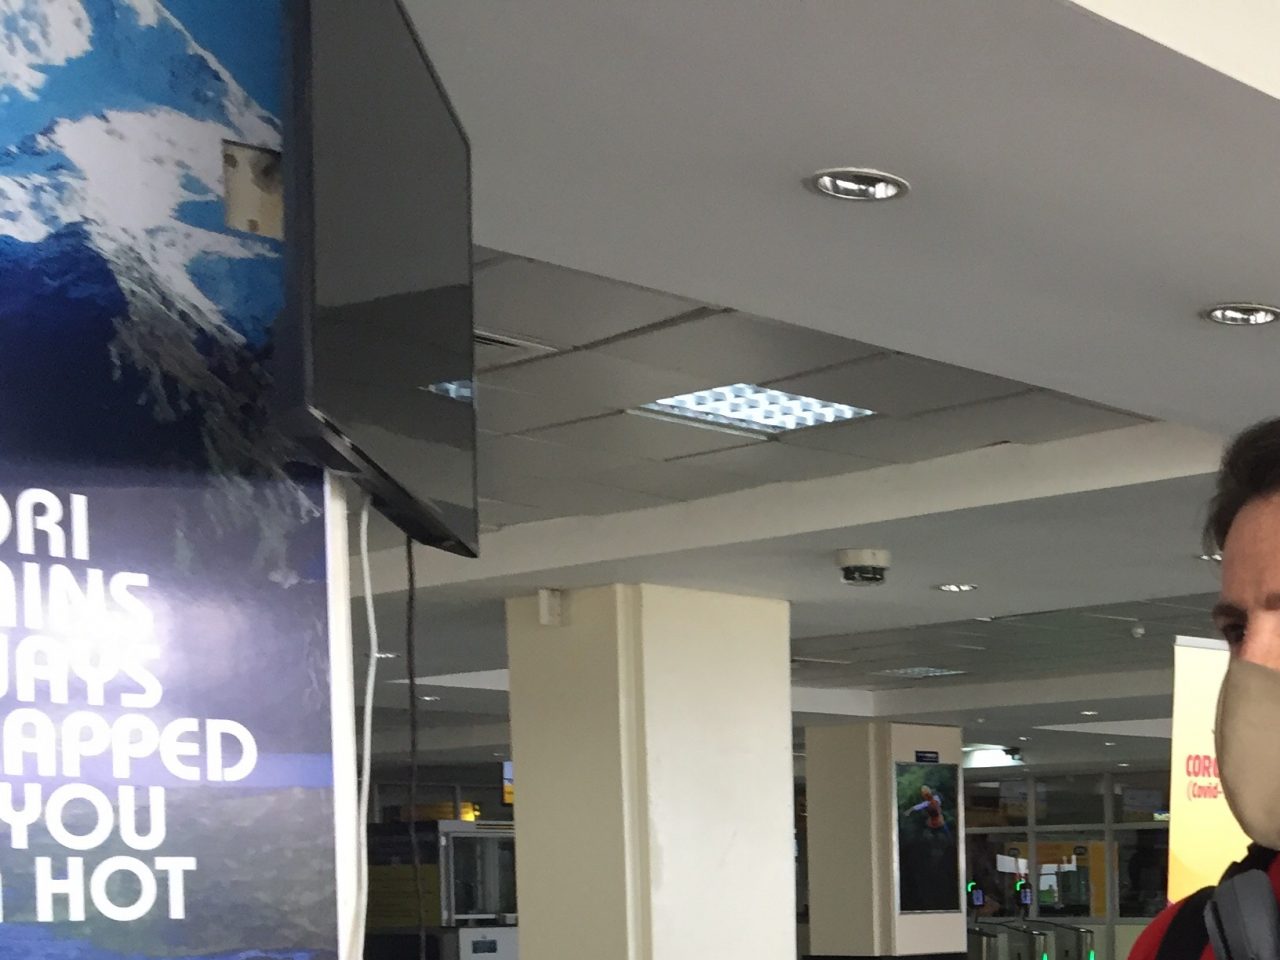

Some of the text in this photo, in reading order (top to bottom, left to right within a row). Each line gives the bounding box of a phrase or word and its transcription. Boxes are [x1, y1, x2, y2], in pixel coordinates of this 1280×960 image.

[0, 487, 90, 561] RI
[0, 633, 163, 708] AYS
[3, 708, 258, 782] APPED
[0, 783, 167, 850] YOU
[35, 856, 197, 922] HOT
